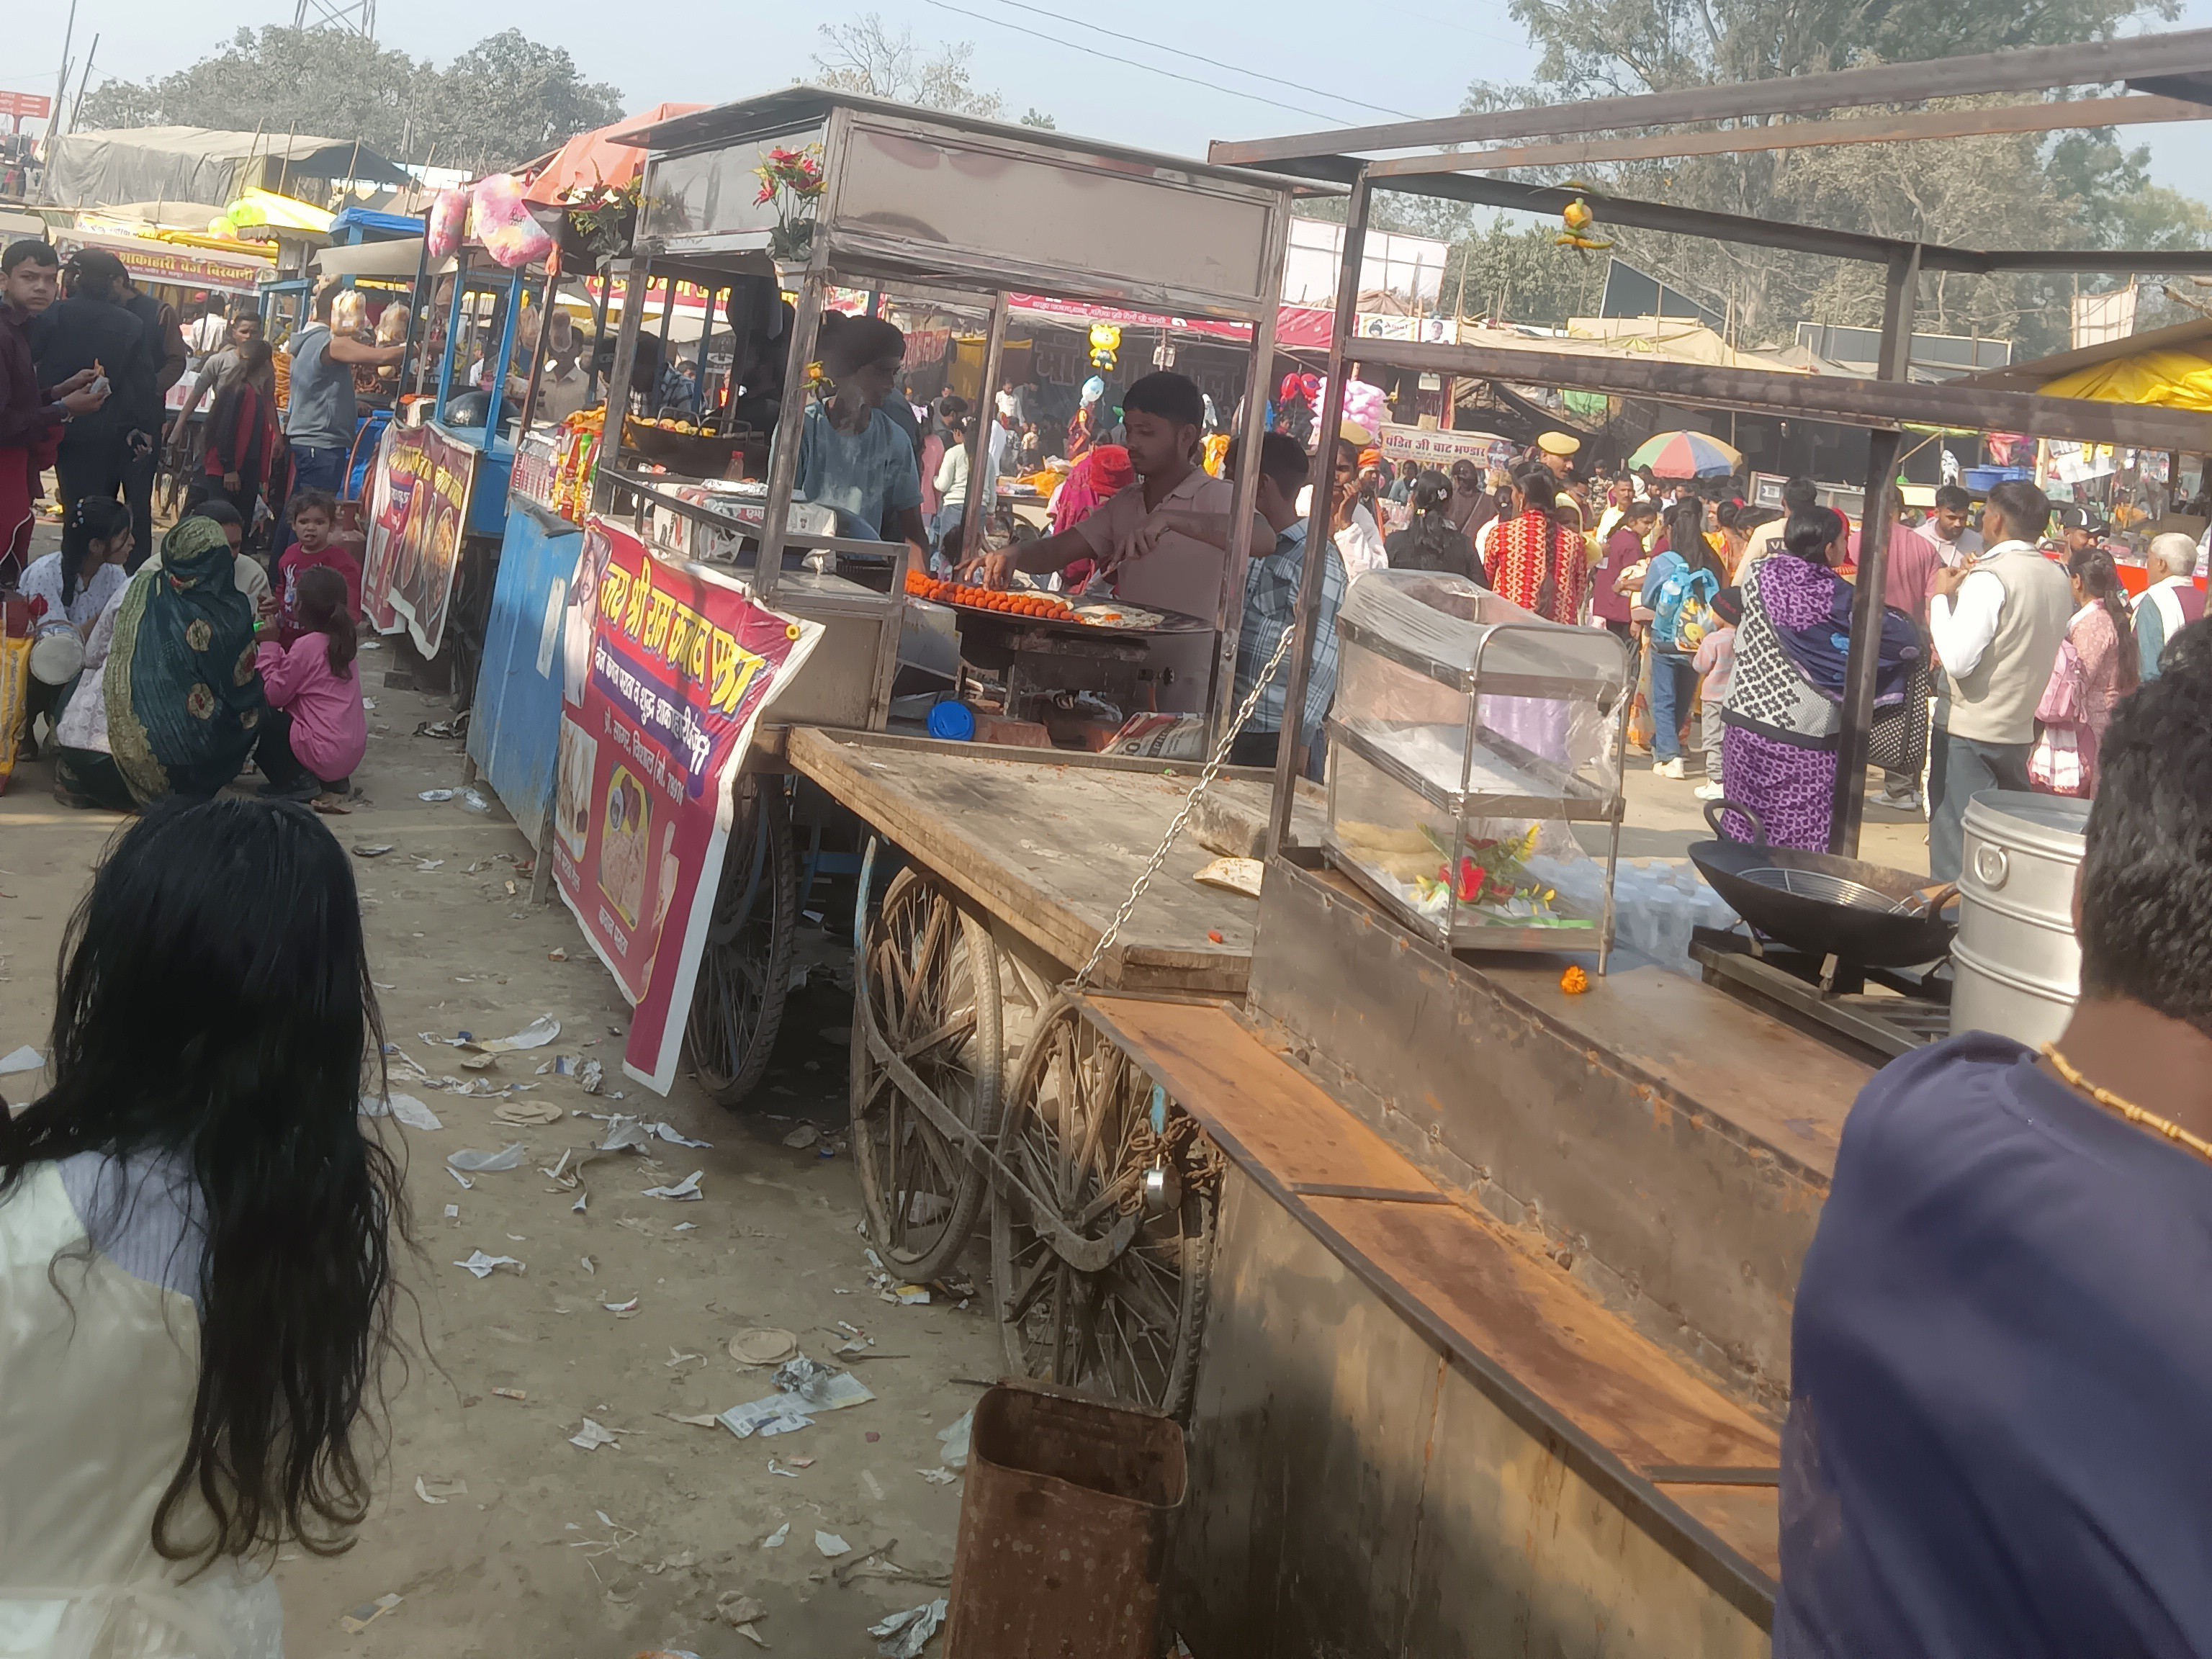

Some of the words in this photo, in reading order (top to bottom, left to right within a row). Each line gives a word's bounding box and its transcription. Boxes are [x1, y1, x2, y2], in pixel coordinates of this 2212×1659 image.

[207, 263, 253, 282] बिरयानी
[1385, 436, 1412, 449] पंडित
[1415, 439, 1430, 451] जी
[1433, 442, 1452, 454] चाट
[1455, 444, 1486, 457] भण्डार
[600, 562, 631, 626] जय
[624, 556, 652, 638] श्री
[642, 586, 677, 654] राम
